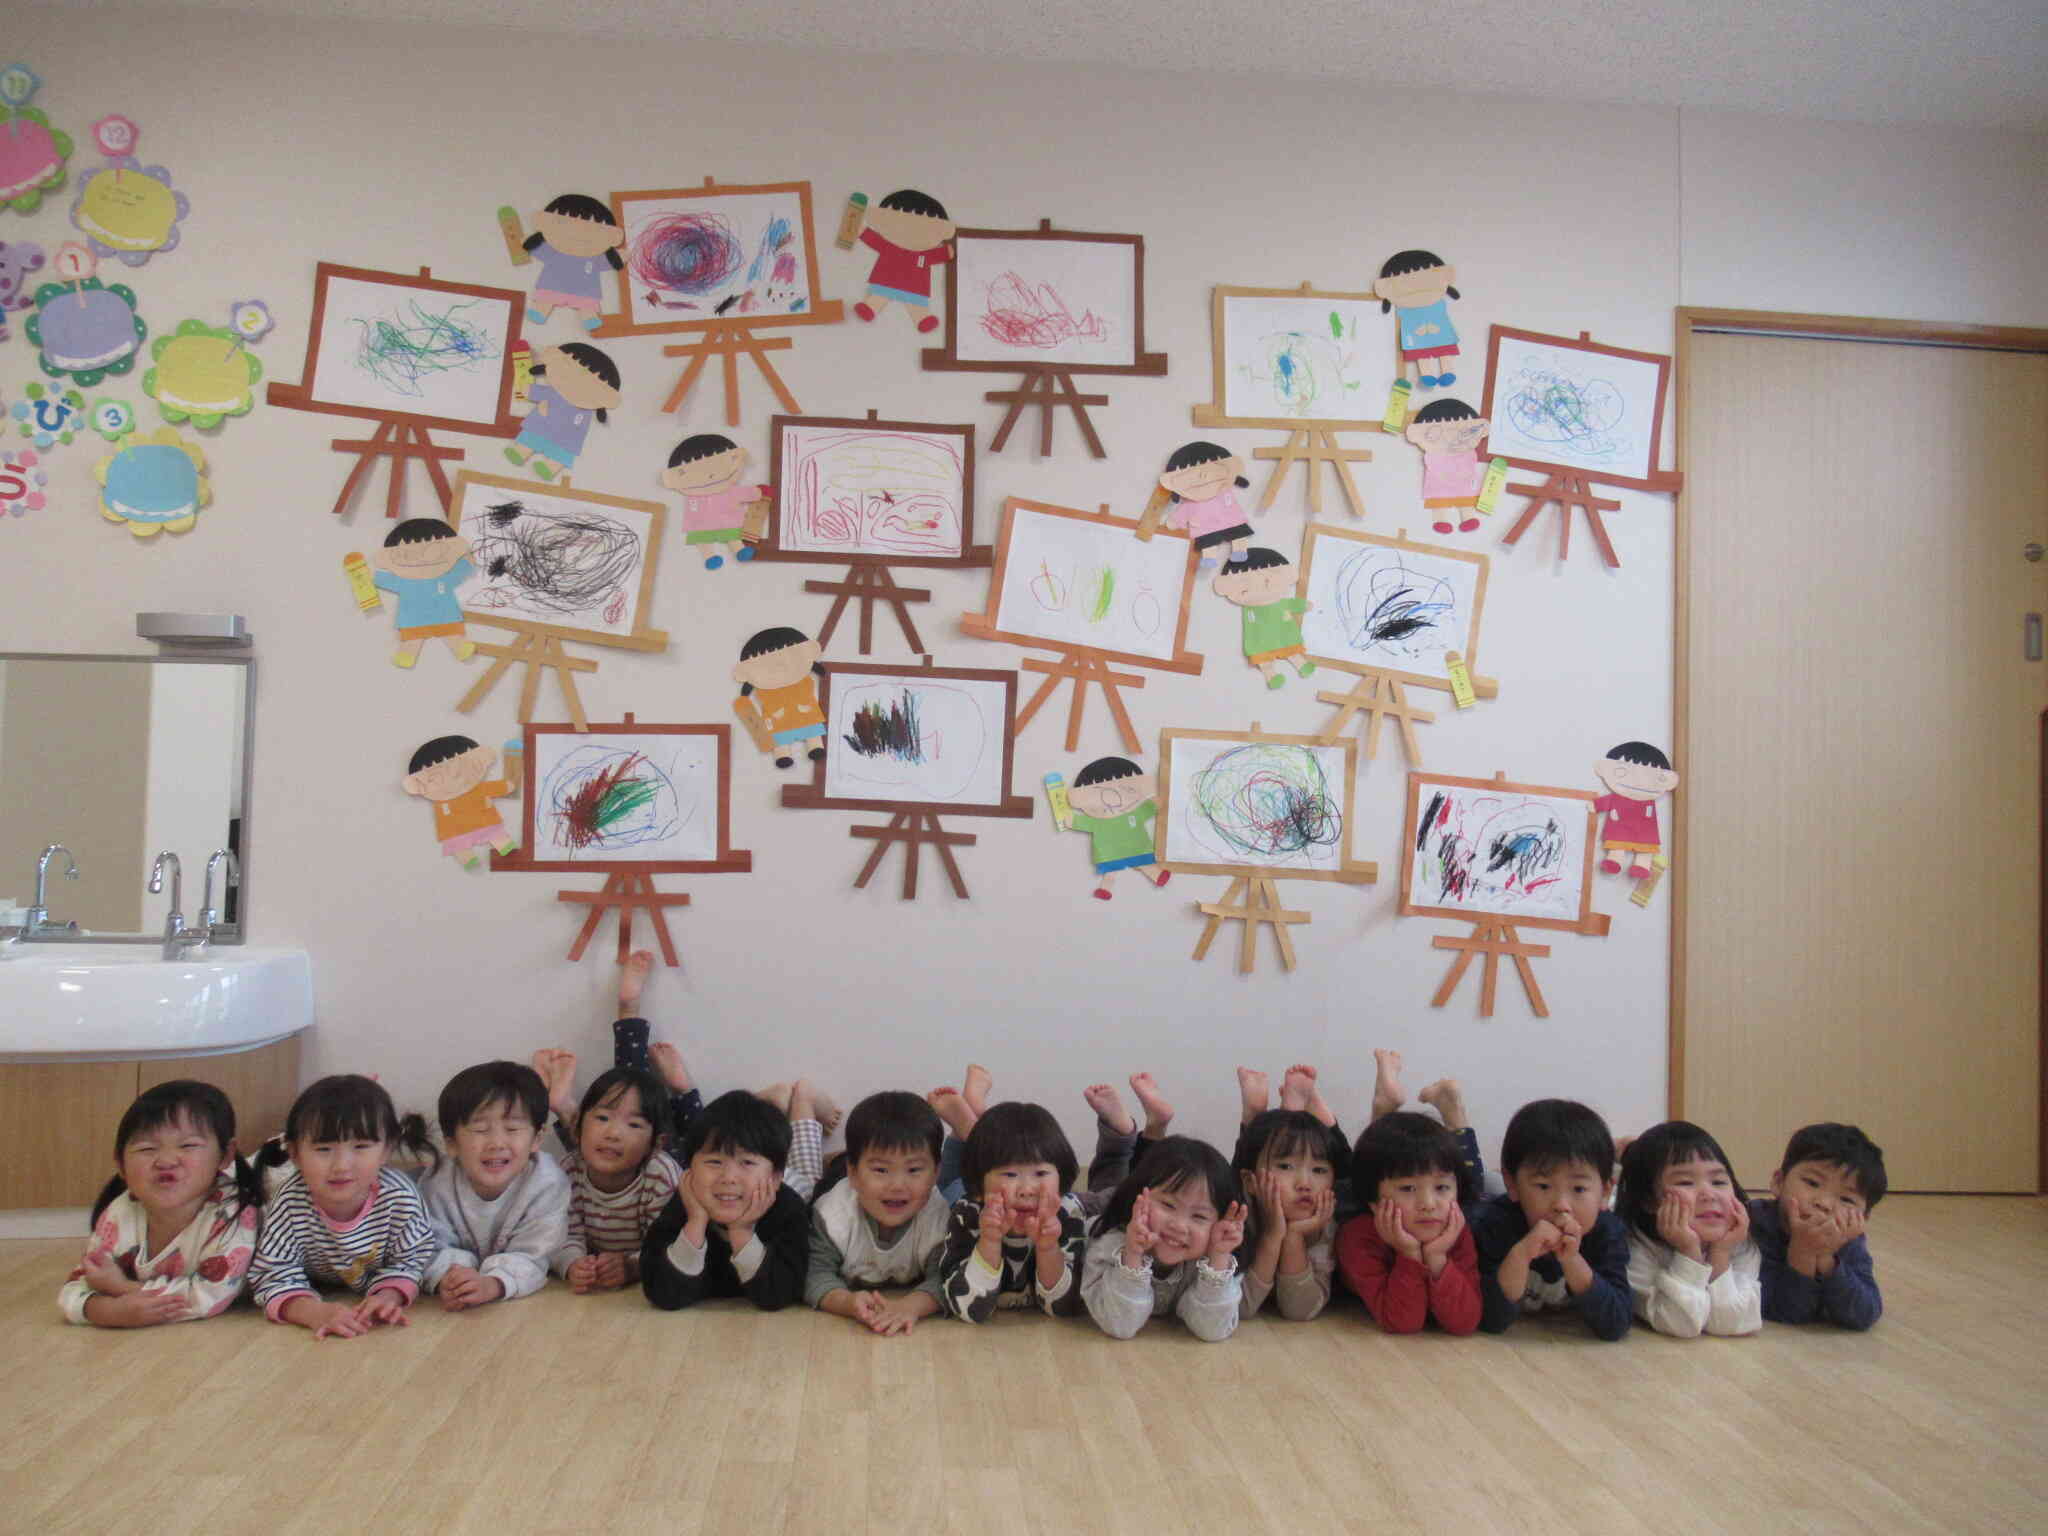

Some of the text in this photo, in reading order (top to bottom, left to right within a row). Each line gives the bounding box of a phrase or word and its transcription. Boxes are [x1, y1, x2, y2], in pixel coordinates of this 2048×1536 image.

[107, 125, 129, 143] 12
[69, 254, 80, 272] 1
[242, 311, 260, 330] 2
[104, 408, 122, 427] 3
